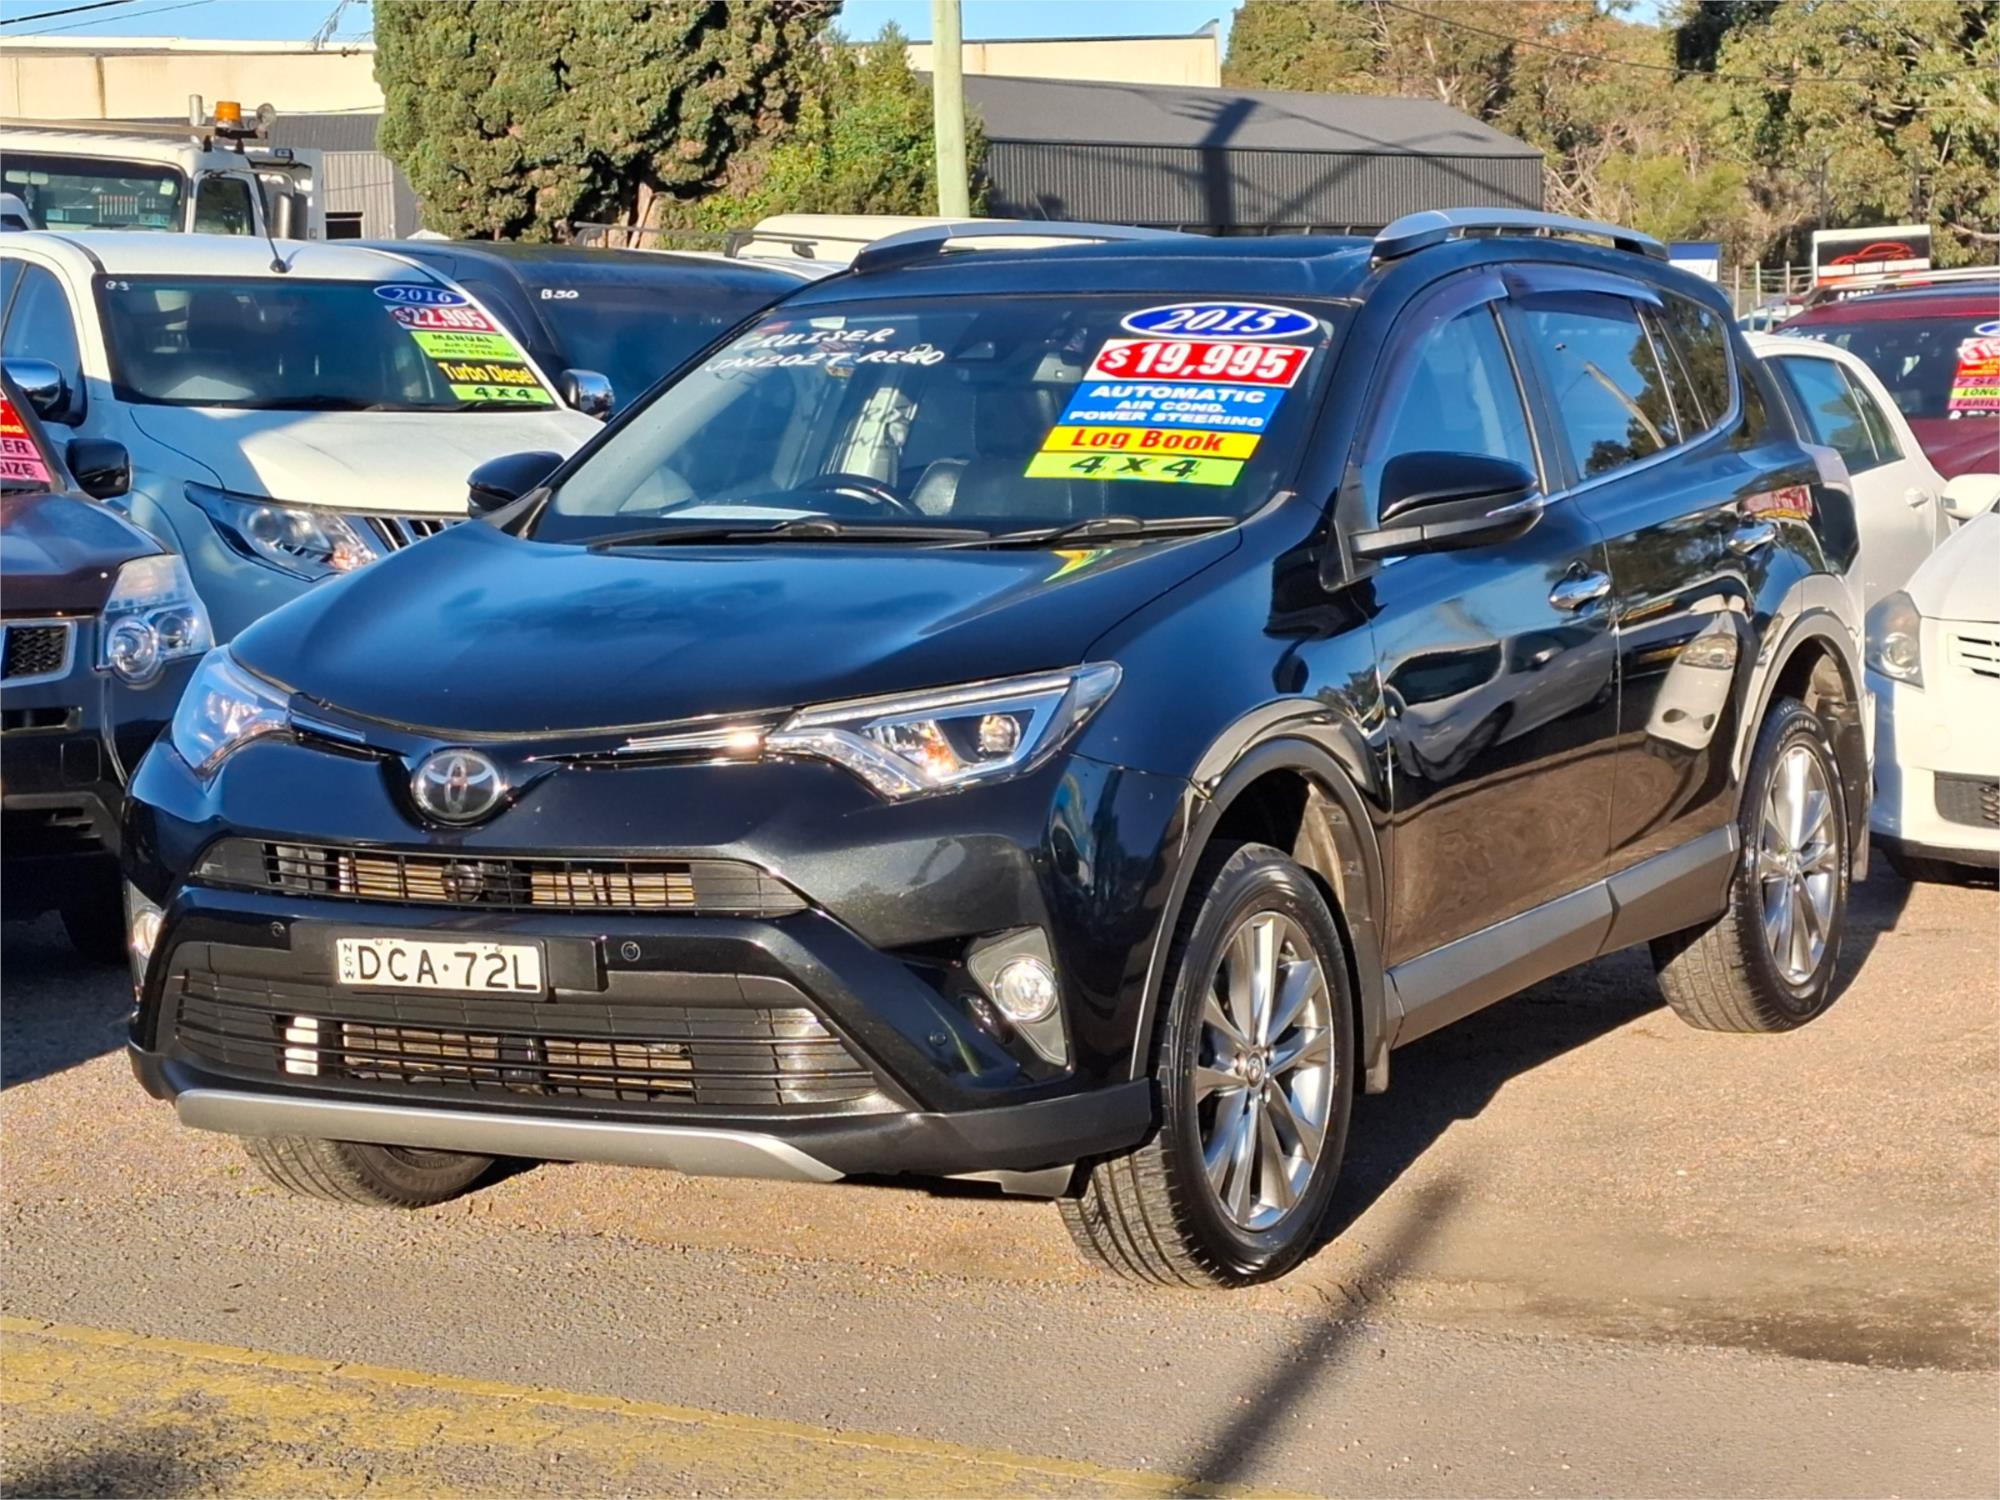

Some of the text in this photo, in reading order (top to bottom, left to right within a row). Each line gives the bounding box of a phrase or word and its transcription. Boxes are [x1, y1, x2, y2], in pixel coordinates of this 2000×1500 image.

[393, 288, 452, 303] 2016
[395, 307, 489, 330] $22,995
[1149, 309, 1289, 332] 2015
[432, 334, 493, 344] MANUAL
[734, 327, 896, 350] CRUISER
[1104, 343, 1294, 378] $19,995
[437, 362, 539, 385] Turbo Diesel
[1089, 385, 1266, 404] AUTOMATIC
[1115, 400, 1227, 413] AIR COND.
[1069, 410, 1265, 428] POWER STEERING
[1071, 428, 1225, 452] Log Book
